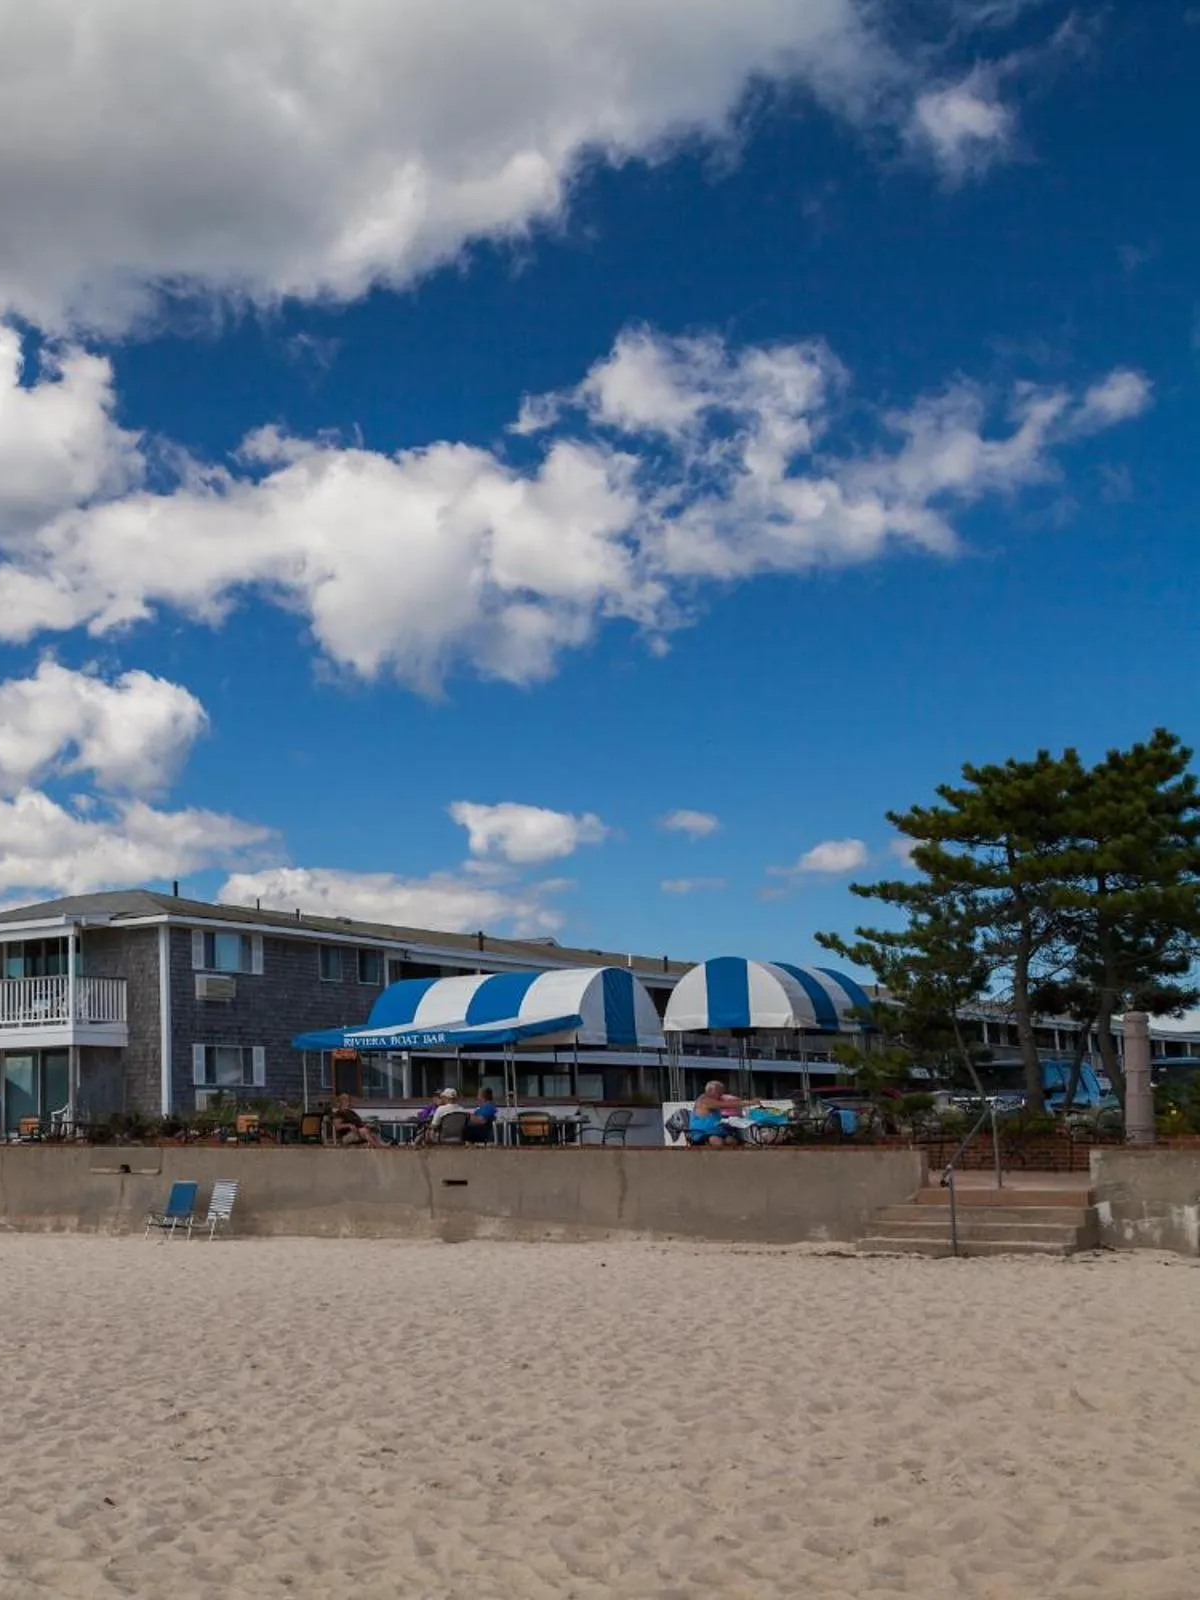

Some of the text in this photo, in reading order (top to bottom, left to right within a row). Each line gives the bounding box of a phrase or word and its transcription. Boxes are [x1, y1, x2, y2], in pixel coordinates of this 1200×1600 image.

[343, 1033, 445, 1047] RIVIERA BOAT BAR
